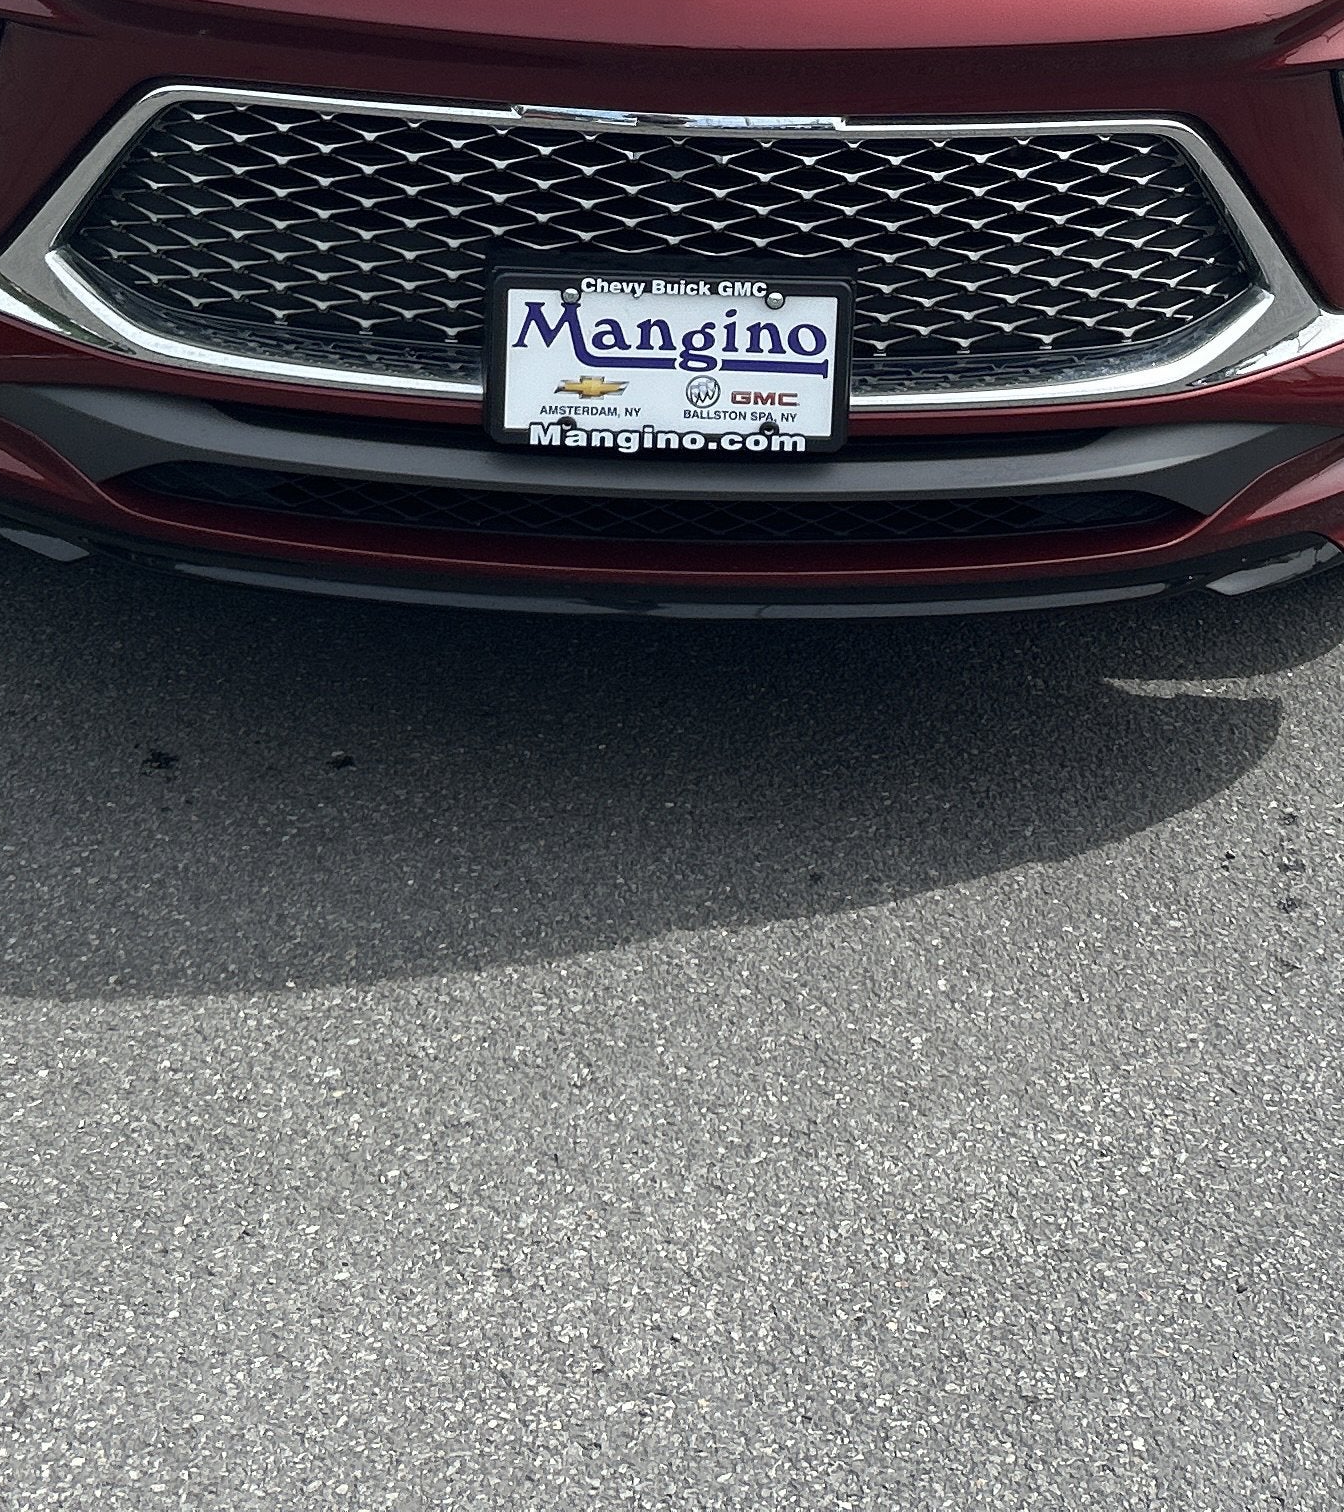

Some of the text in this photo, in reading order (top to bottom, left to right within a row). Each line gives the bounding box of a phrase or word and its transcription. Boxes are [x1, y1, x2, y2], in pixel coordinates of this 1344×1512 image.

[580, 277, 768, 298] Chevy Buick GMC
[512, 301, 829, 373] Mangino
[730, 390, 801, 407] GMC
[539, 404, 642, 419] AMSTERDAM, NY
[683, 408, 798, 423] BALLSTON SPA, NY
[529, 423, 806, 453] Mangino.com
